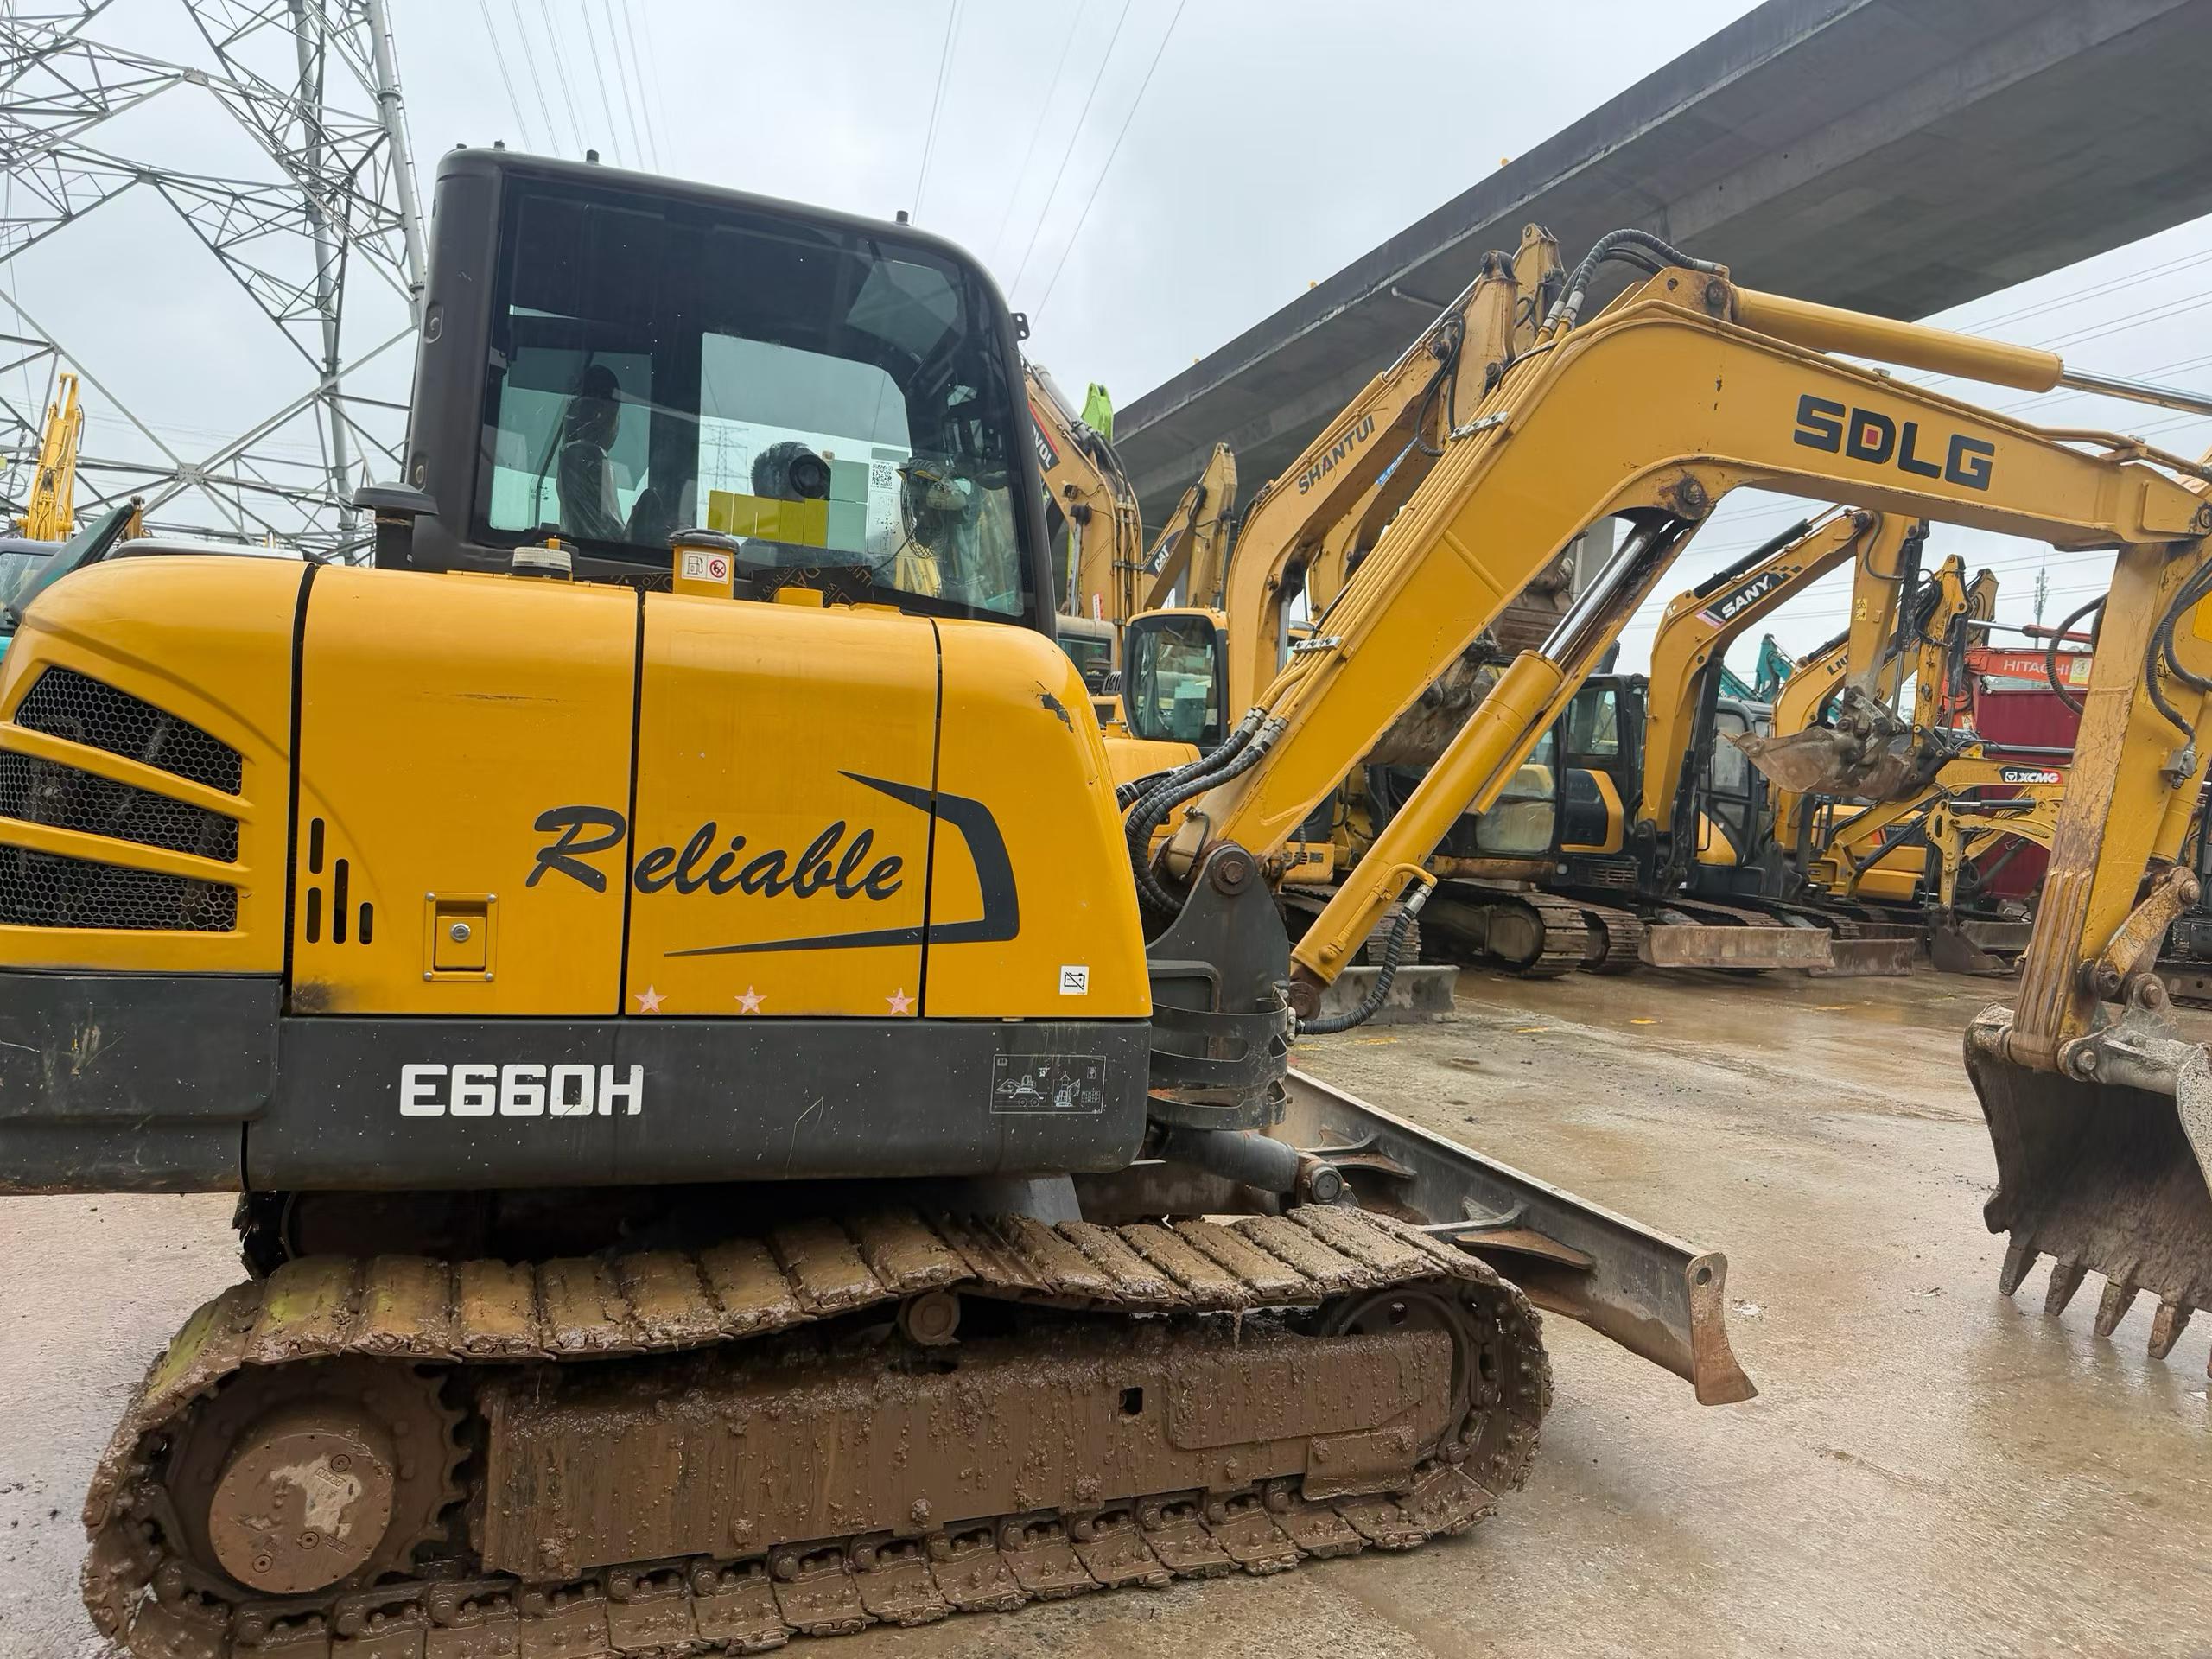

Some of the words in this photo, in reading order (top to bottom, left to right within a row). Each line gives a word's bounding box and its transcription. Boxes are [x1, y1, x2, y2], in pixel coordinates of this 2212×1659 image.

[1032, 423, 1052, 469] VOL
[1299, 415, 1376, 495] SHANTUI
[1794, 394, 1995, 492] SDLG
[1154, 543, 1170, 573] CAT
[1721, 575, 1770, 620] SANY
[2018, 772, 2060, 784] XCMG
[525, 805, 904, 901] Reliable
[399, 1064, 645, 1116] E660H
